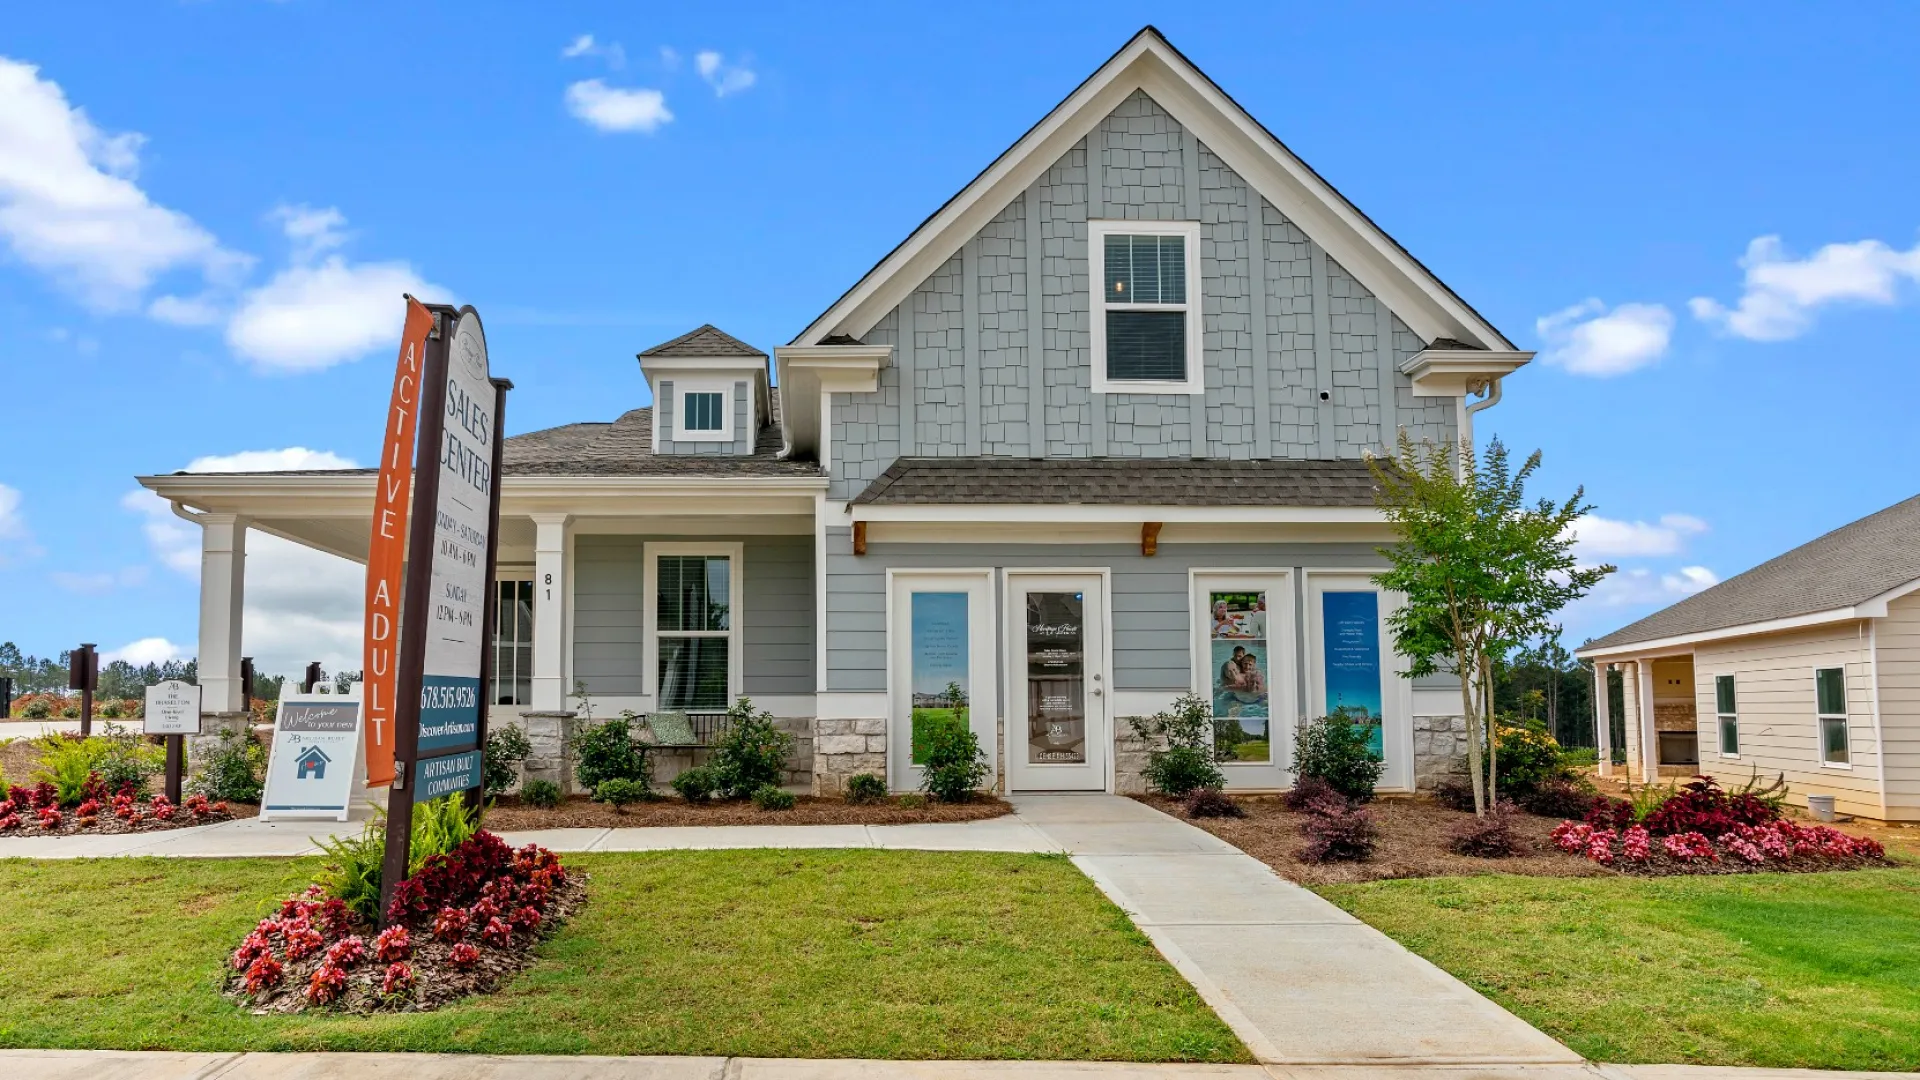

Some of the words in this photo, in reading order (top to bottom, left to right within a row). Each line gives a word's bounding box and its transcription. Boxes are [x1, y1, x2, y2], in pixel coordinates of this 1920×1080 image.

[446, 378, 489, 446] SALES
[380, 341, 416, 539] ACTIVE
[440, 426, 490, 497] CENTER
[544, 573, 552, 601] 81
[371, 579, 391, 746] ADULT
[420, 685, 476, 710] 678.515.9526
[283, 707, 338, 730] Welcome
[317, 721, 335, 730] your
[336, 721, 354, 729] new
[424, 758, 456, 780] ARTISAN
[456, 755, 474, 773] BUILT
[427, 773, 470, 796] COMMUNITIES
